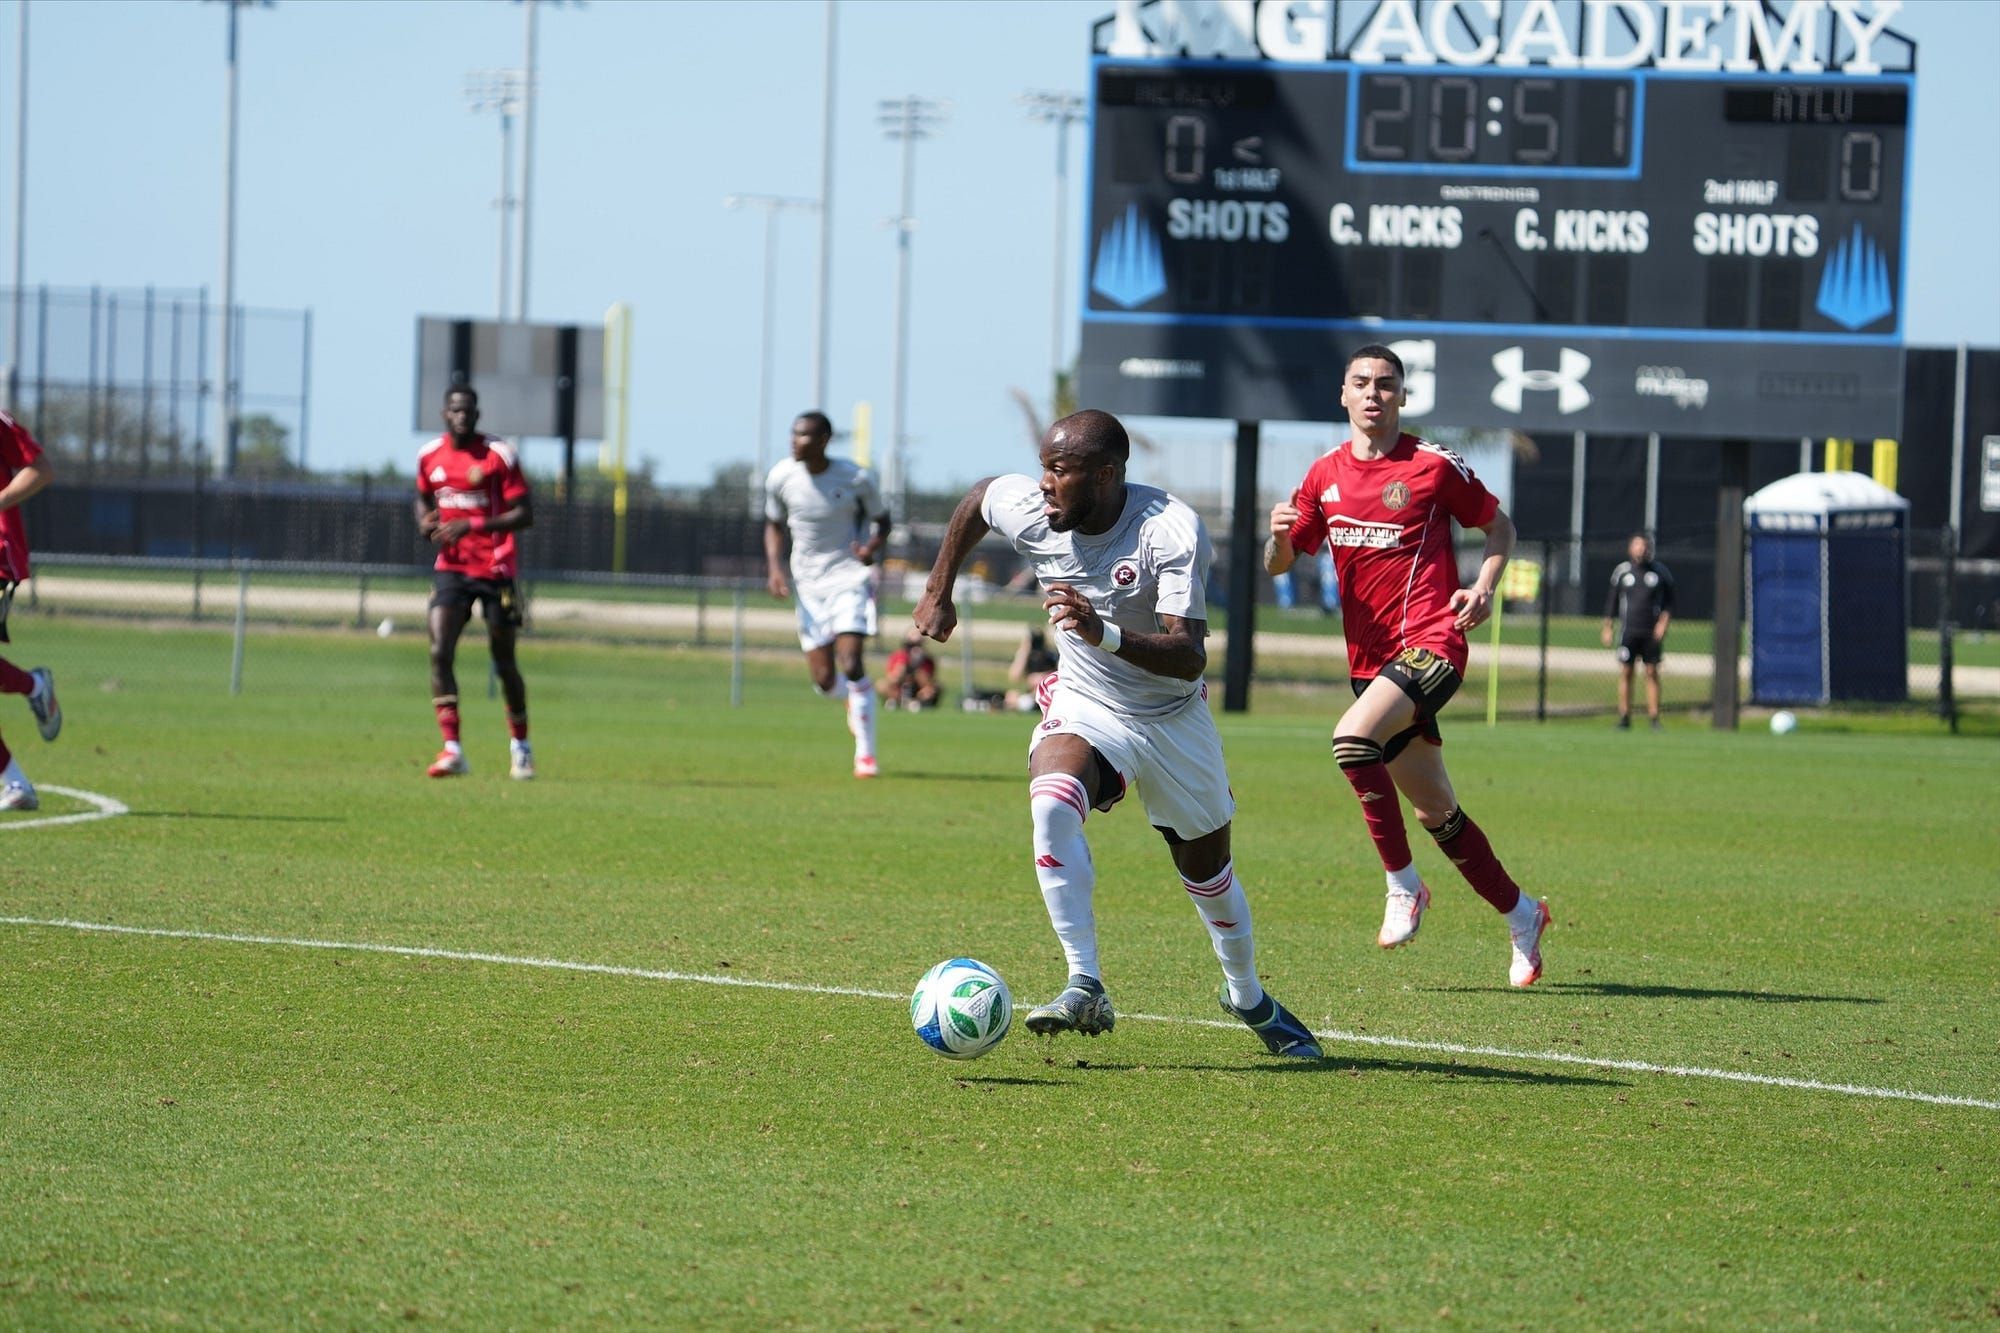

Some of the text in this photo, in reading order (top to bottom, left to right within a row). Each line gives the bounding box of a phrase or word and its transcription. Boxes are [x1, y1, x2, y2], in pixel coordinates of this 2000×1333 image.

[1350, 0, 1899, 75] ACADEMY
[1362, 76, 1627, 162] 20:51
[1165, 115, 1205, 184] 0
[1840, 131, 1881, 200] 0
[1167, 198, 1290, 242] SHOTS
[1329, 202, 1463, 248] C. KICKS
[1514, 207, 1650, 254] C. KICKS
[1693, 211, 1820, 257] SHOTS
[1364, 527, 1402, 540] FAMILY
